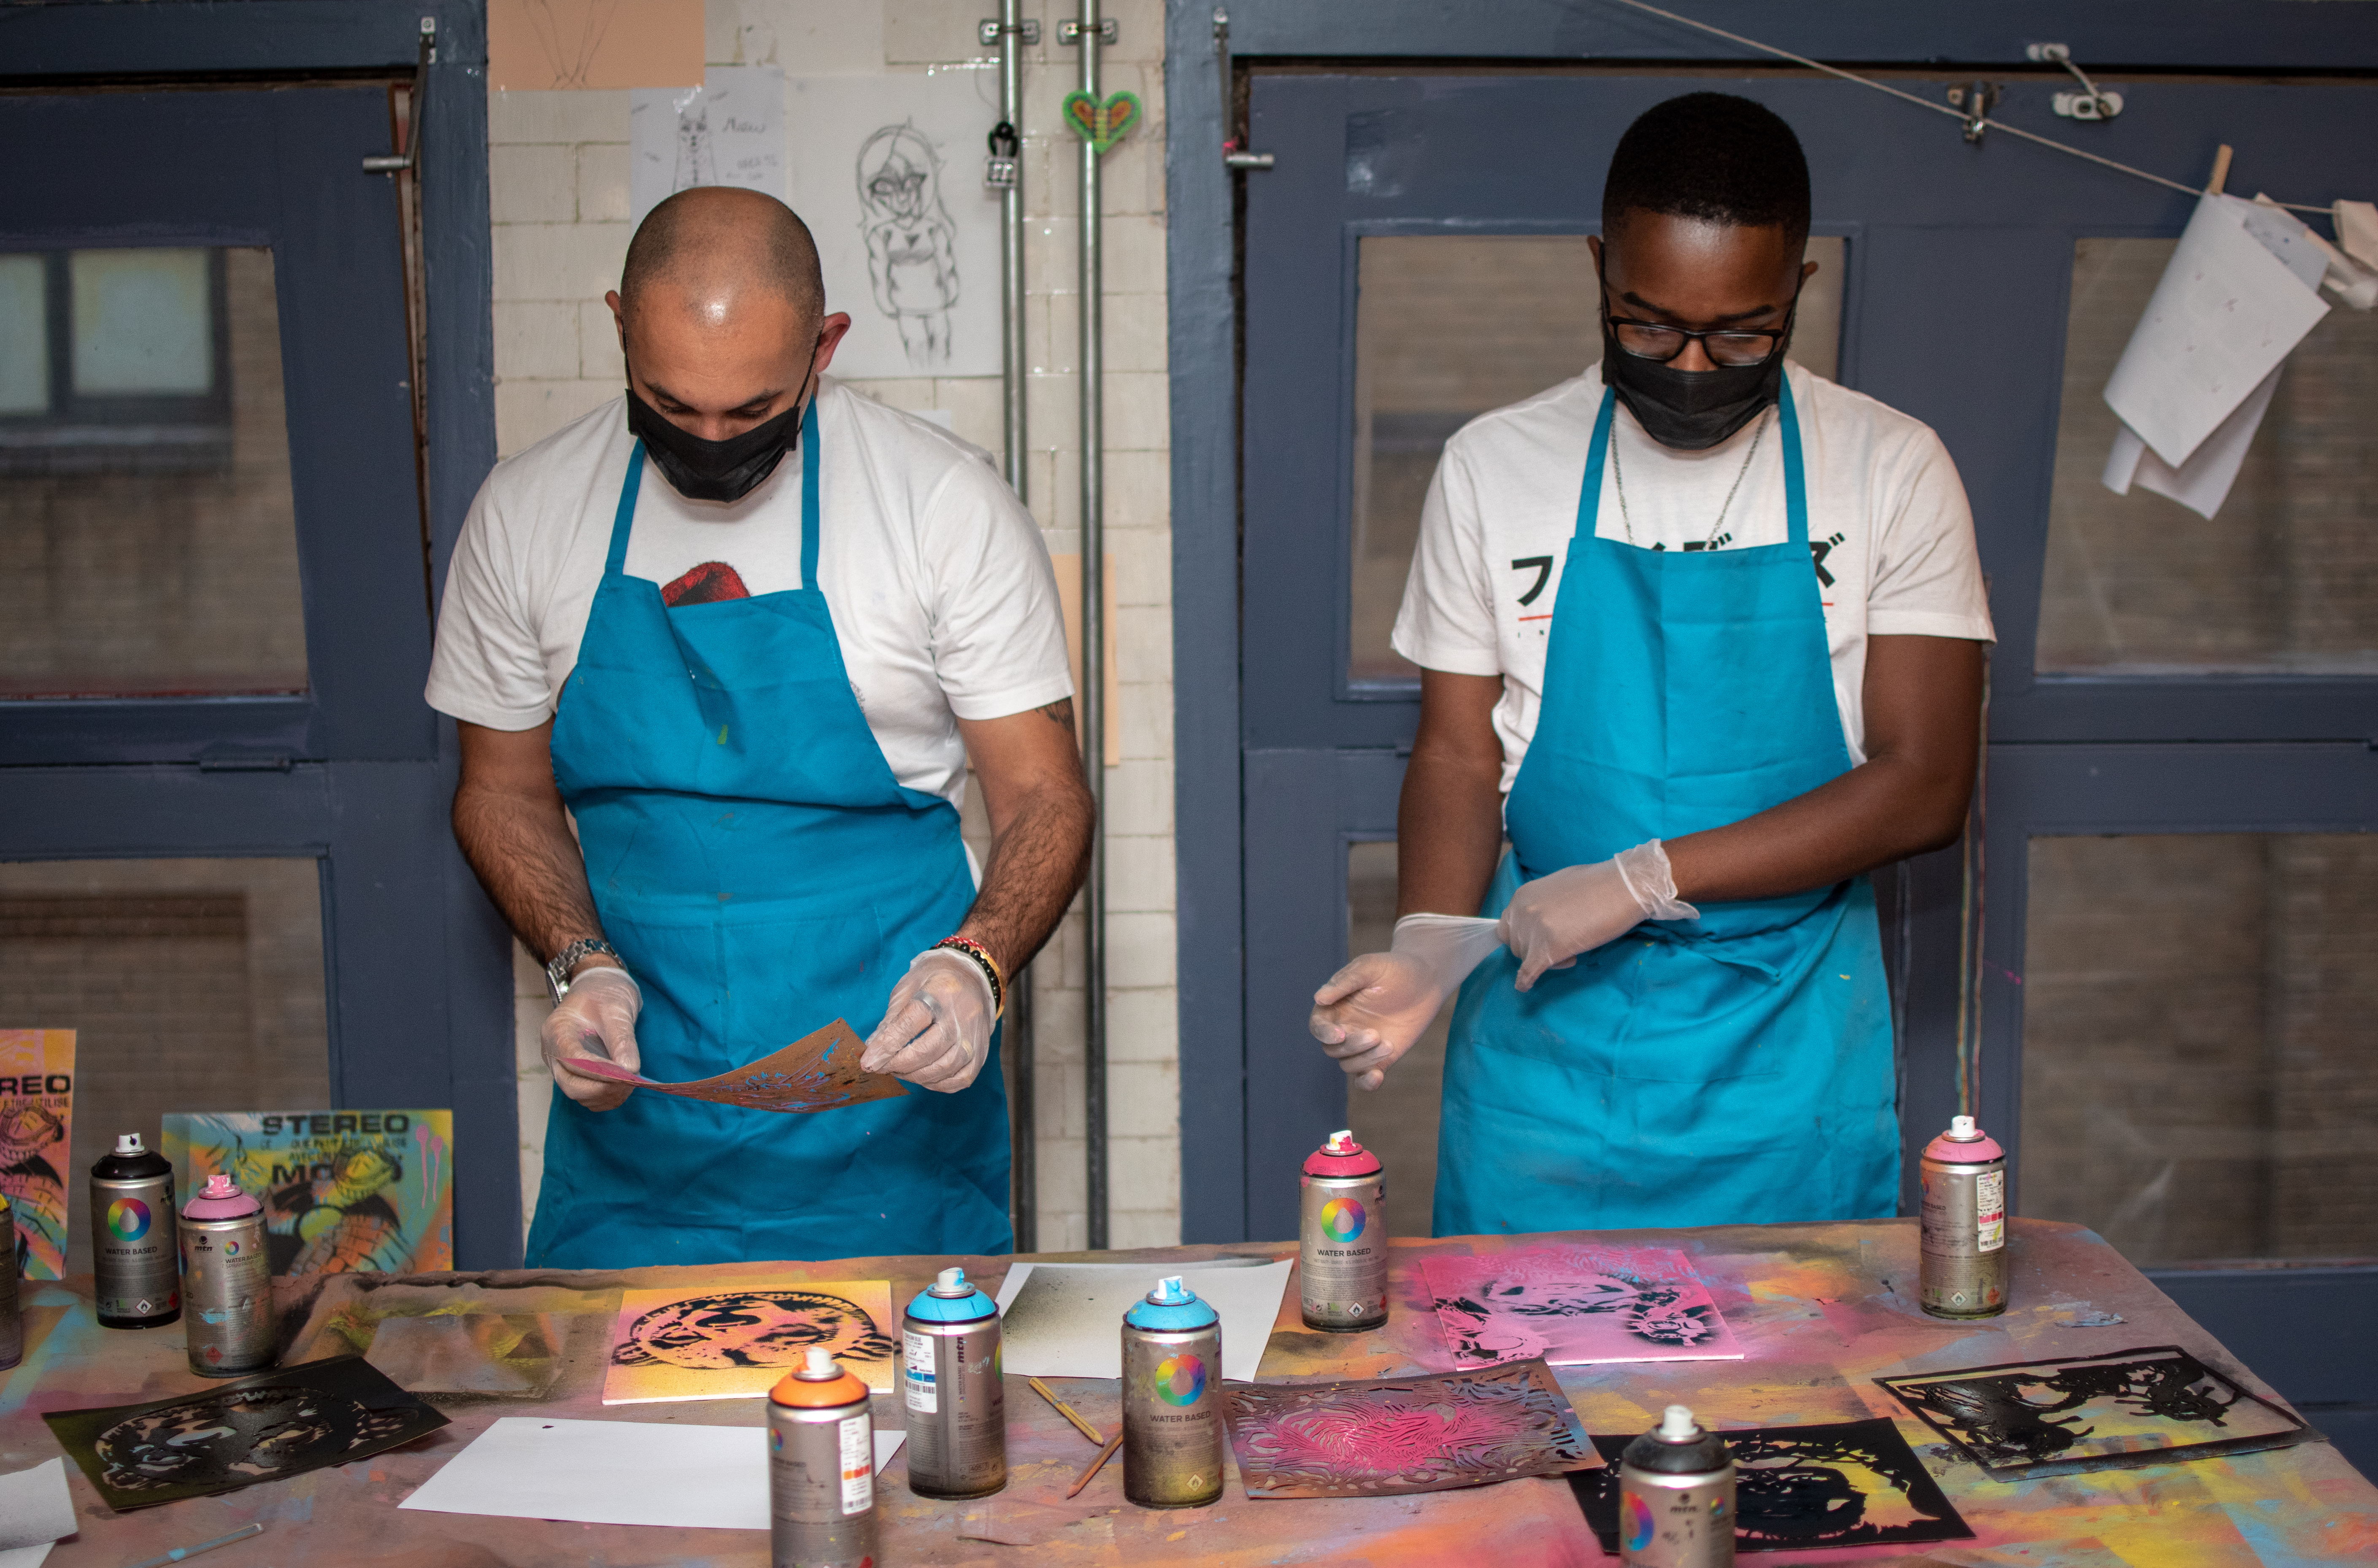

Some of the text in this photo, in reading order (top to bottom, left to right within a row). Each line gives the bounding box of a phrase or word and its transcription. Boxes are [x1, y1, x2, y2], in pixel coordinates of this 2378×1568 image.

[262, 1114, 409, 1136] STEREO
[132, 1246, 157, 1255] BASED
[1317, 1248, 1371, 1257] WATER BASED
[1150, 1411, 1211, 1422] WATER BASED
